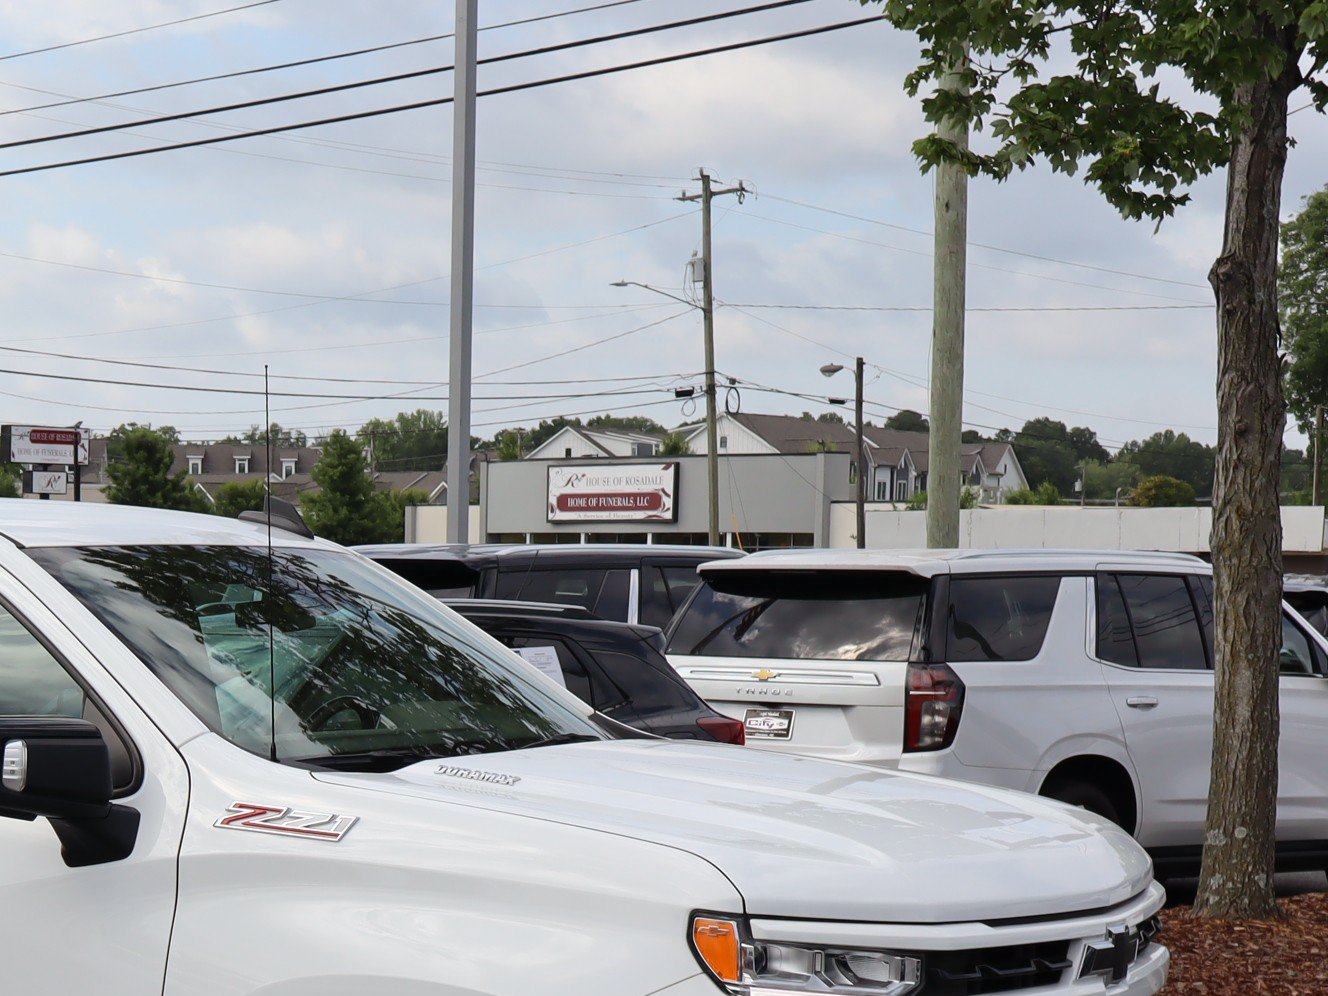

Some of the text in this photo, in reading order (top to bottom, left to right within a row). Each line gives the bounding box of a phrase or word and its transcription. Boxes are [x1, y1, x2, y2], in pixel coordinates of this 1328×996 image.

[586, 476, 611, 487] HOUSE
[613, 476, 623, 486] OF
[625, 475, 663, 487] ROSADALE
[567, 496, 649, 508] HOME OF FUNERALS, LLC
[736, 687, 793, 696] TAHOE
[748, 719, 774, 729] City
[434, 765, 522, 786] DURAMAX
[213, 801, 360, 842] Z71
